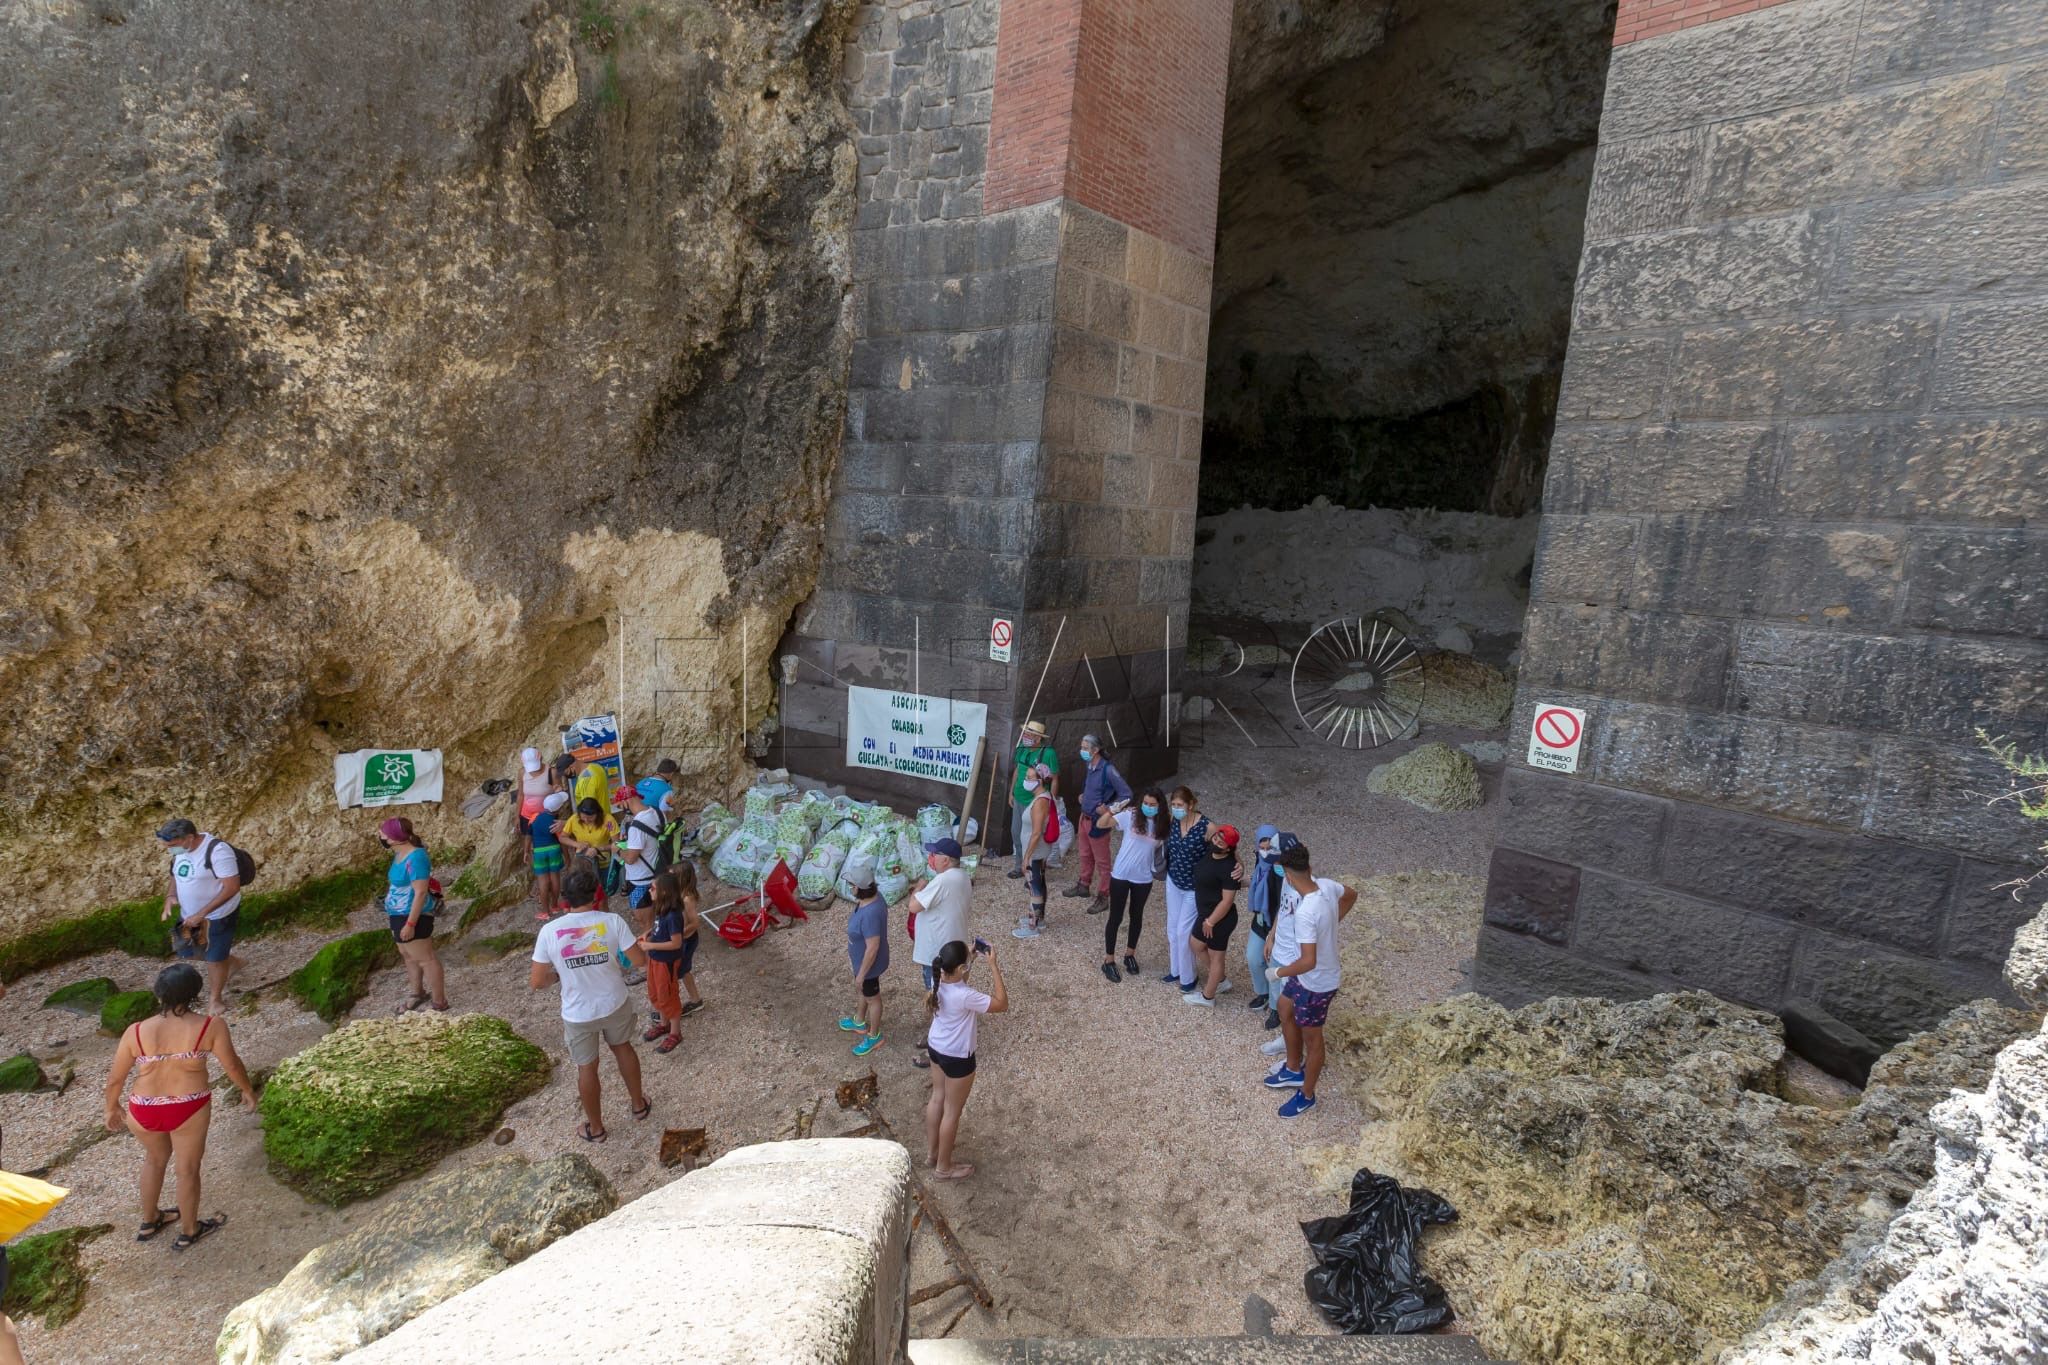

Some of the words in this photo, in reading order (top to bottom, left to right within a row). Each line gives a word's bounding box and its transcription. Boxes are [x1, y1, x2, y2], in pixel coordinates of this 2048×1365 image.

[891, 719, 924, 735] COLABORA
[863, 737, 876, 750] CON
[912, 746, 934, 761] MEDIO
[935, 750, 971, 767] AMBIENTE
[1533, 750, 1572, 763] PROHIBIDO
[858, 751, 889, 768] GUELAYA
[894, 758, 938, 776] ECOLOGISTAS
[939, 765, 949, 779] EN
[1536, 758, 1545, 766] EL
[1546, 761, 1568, 770] PASO
